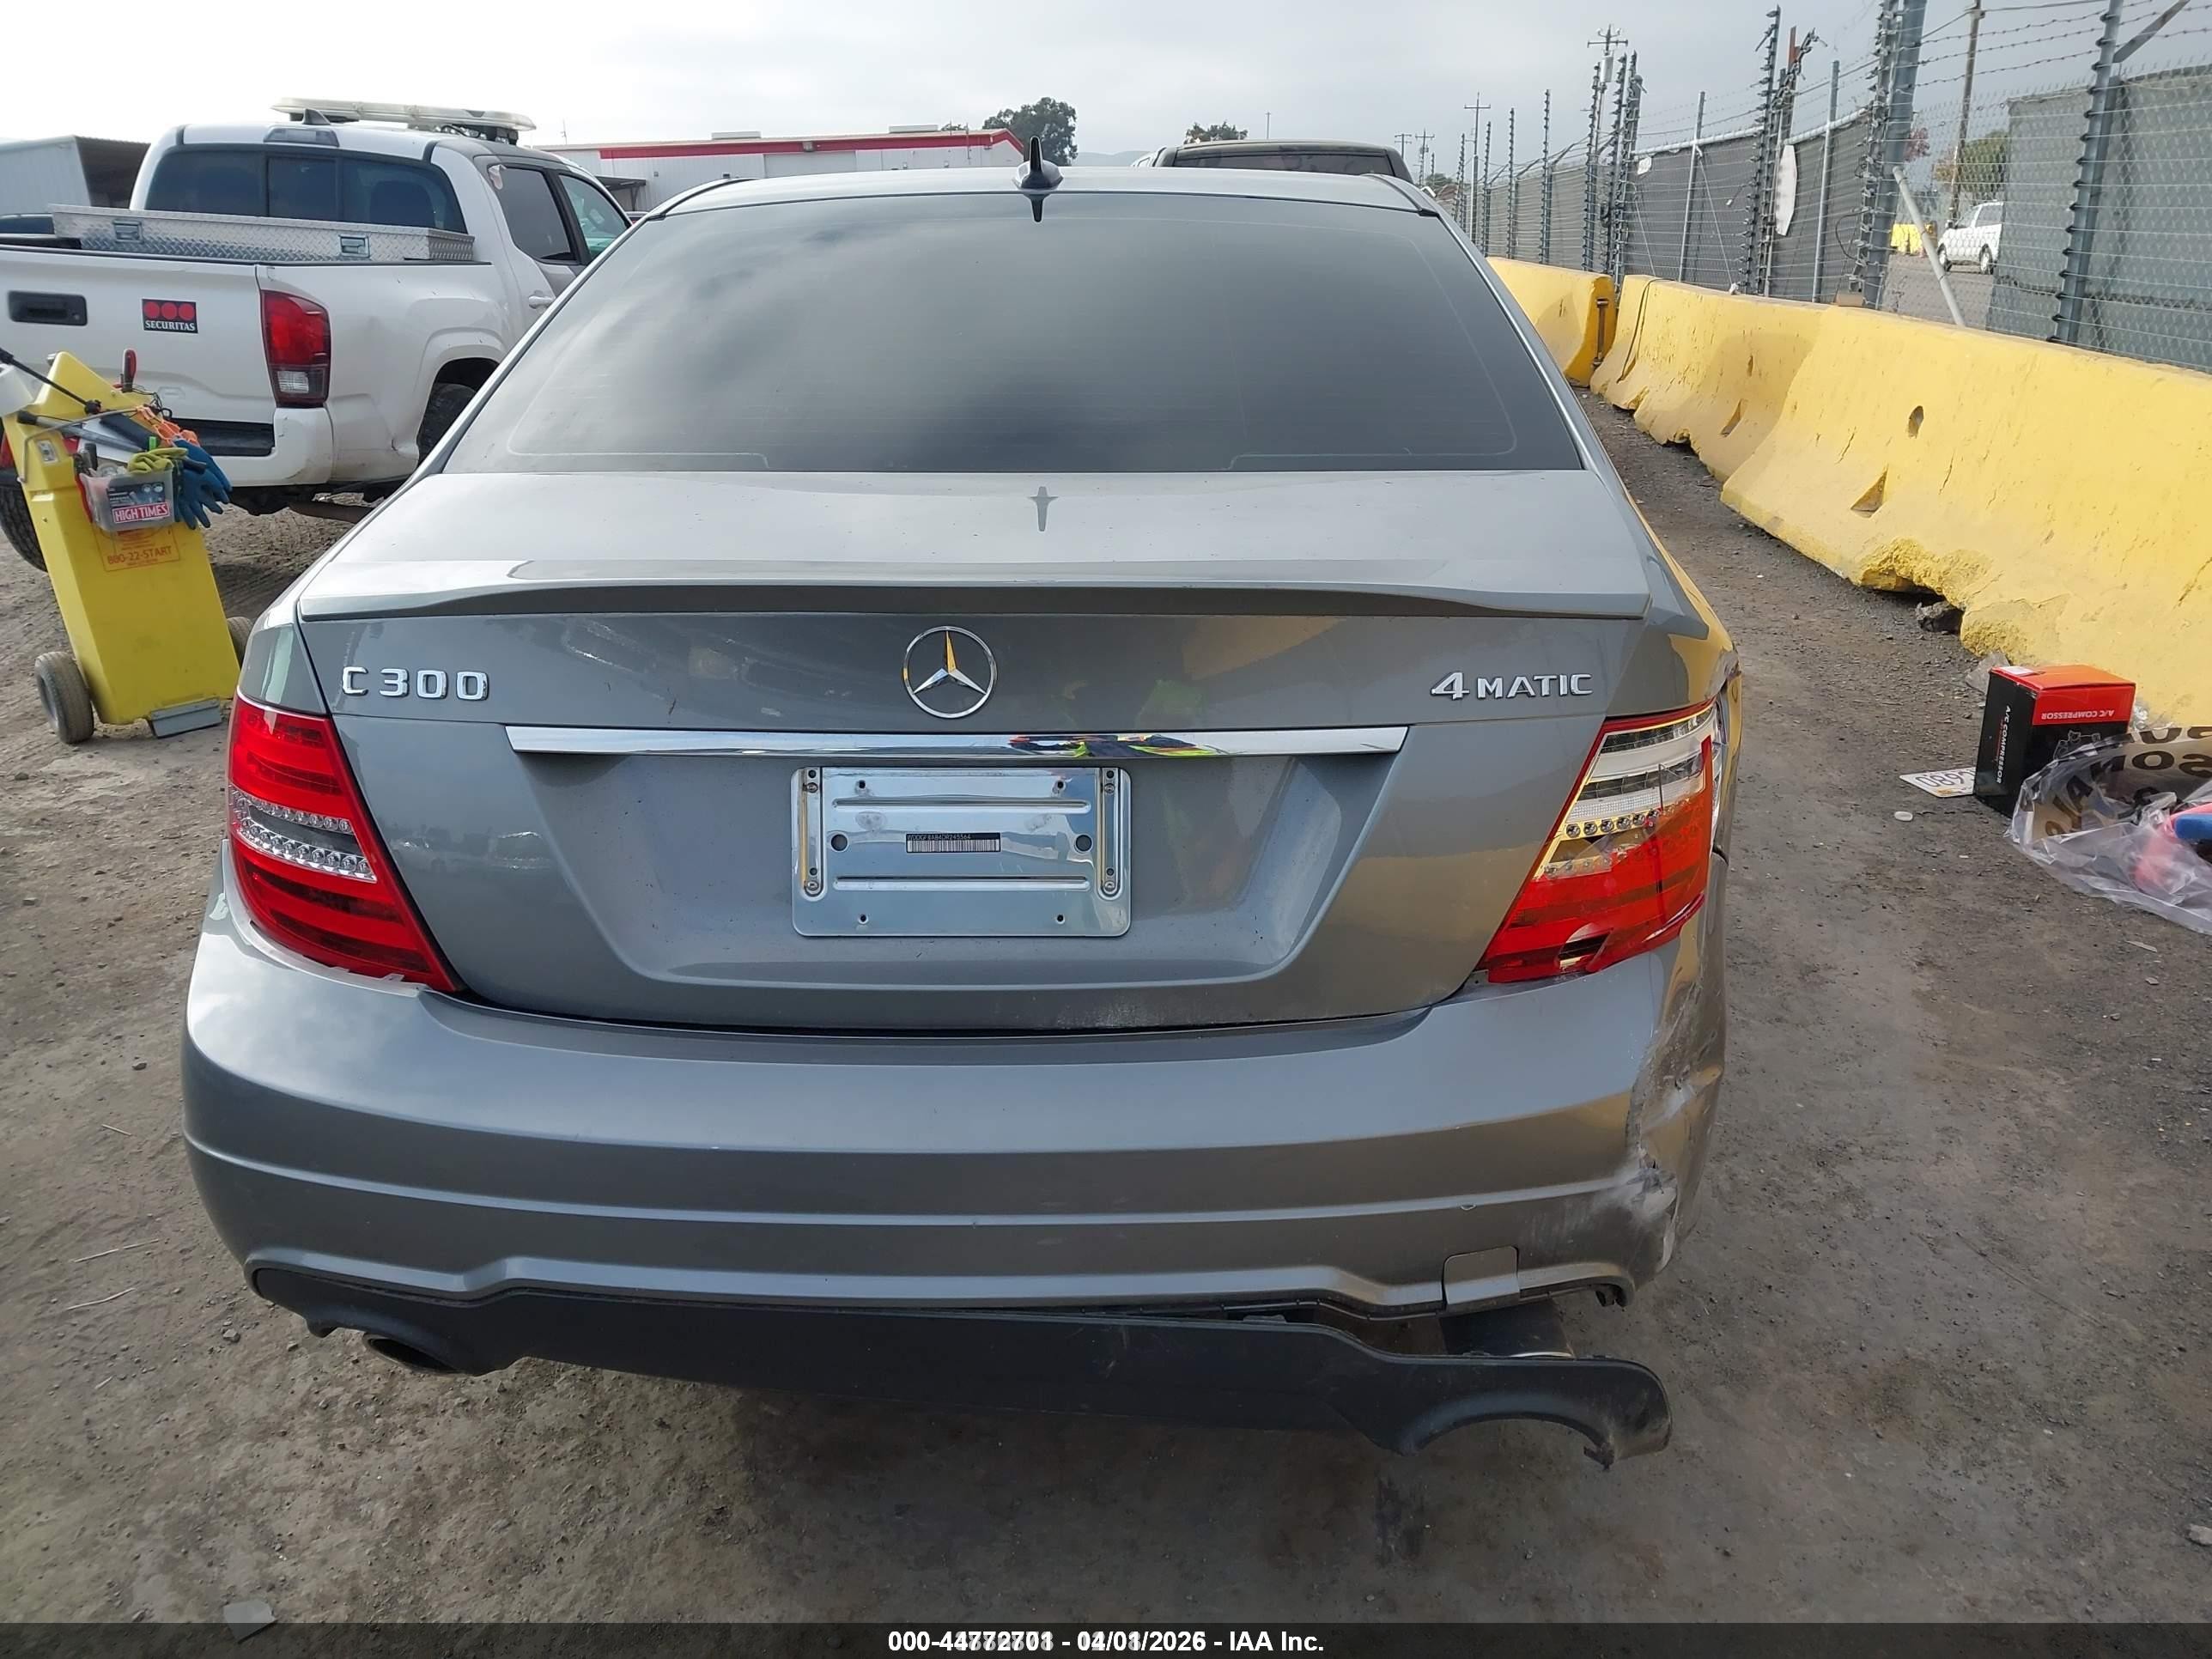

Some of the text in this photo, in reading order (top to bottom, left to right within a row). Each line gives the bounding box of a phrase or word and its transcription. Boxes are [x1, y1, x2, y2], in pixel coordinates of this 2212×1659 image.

[145, 320, 195, 331] SECURITAS
[114, 504, 167, 522] HIGH TIMES
[2041, 709, 2115, 720] A/C COMPRESSOR
[1996, 723, 2008, 784] COMPRESSOR
